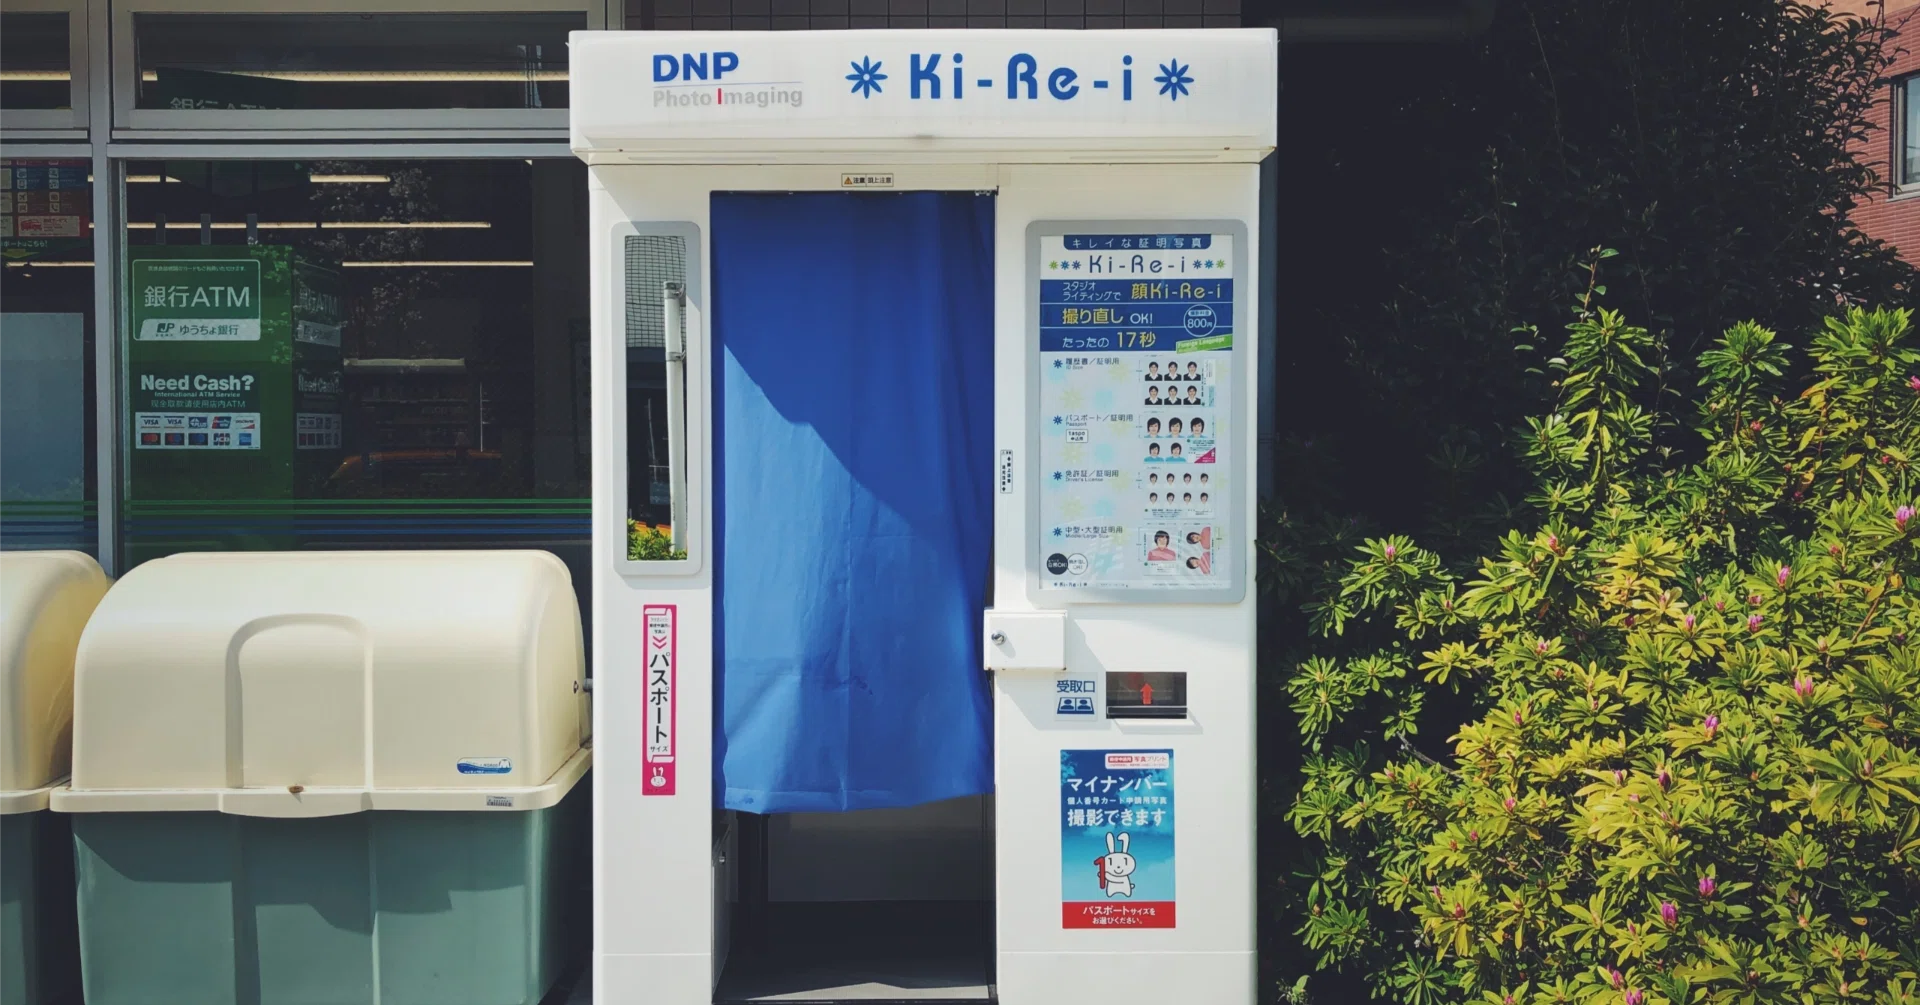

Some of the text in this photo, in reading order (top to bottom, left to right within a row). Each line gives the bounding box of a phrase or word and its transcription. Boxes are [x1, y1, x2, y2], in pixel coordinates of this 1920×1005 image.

[653, 52, 739, 82] DNP
[911, 53, 1132, 100] Ki-Re-i
[653, 87, 803, 107] Photo Imaging
[1072, 237, 1202, 249] キレイな証明写真
[1089, 254, 1185, 273] Ki-Re-i
[1063, 281, 1096, 290] スタジオ
[1131, 282, 1221, 299] 顔Ki-Re-i
[144, 286, 250, 308] 銀行ATM
[1063, 291, 1121, 301] ライティングで
[1062, 308, 1153, 324] 撮り直し OK!
[1187, 318, 1213, 328] 800円
[156, 322, 175, 333] JP
[179, 324, 239, 336] ゆうちょ銀行
[1062, 331, 1156, 348] たったの 17秒
[141, 374, 255, 391] Need Cash?
[1056, 680, 1095, 693] 受取口
[650, 651, 671, 743] パスポート
[1067, 776, 1167, 793] マイナンバー
[1067, 808, 1166, 827] 撮影できます
[1083, 905, 1156, 915] パスポートサイズを
[1092, 916, 1143, 924] お選びください。
